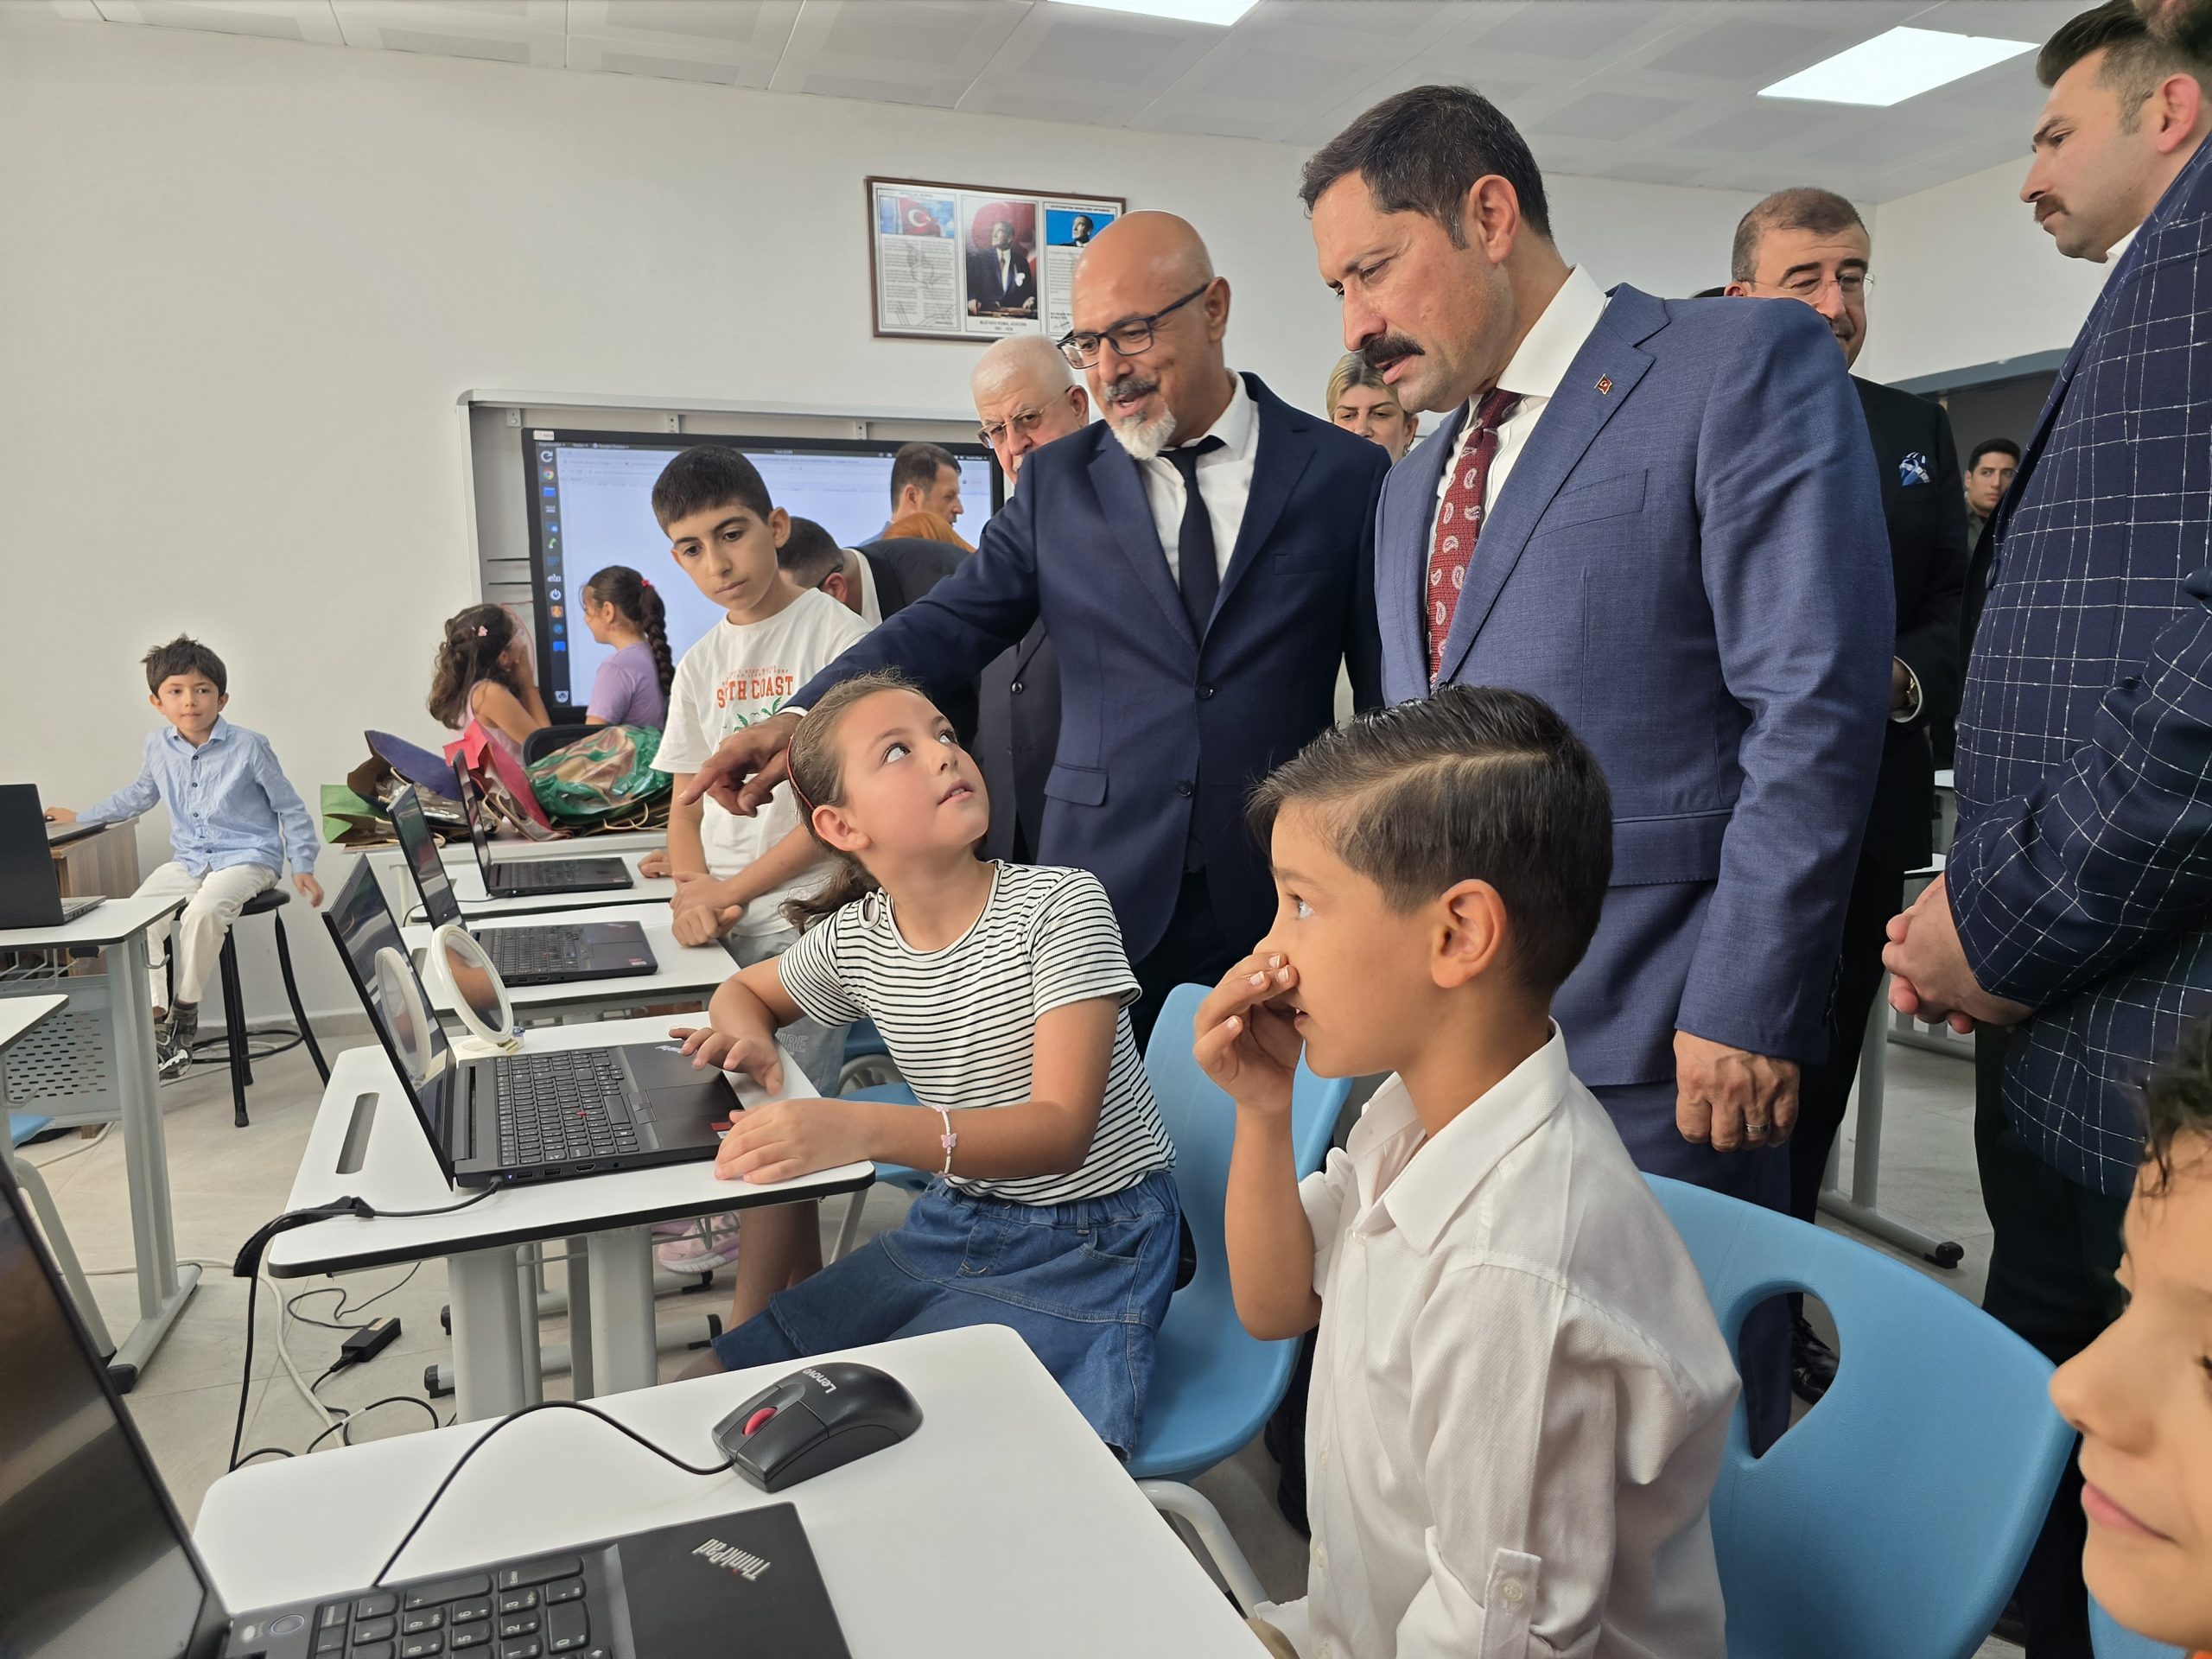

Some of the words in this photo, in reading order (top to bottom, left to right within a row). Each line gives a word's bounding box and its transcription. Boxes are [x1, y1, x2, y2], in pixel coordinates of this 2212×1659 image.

[752, 675, 795, 700] COAST
[802, 1368, 837, 1394] Lenovo
[691, 1538, 772, 1581] ThinkPad
[410, 1621, 423, 1630] 9
[506, 1624, 520, 1632] 2
[408, 1645, 423, 1654] 8
